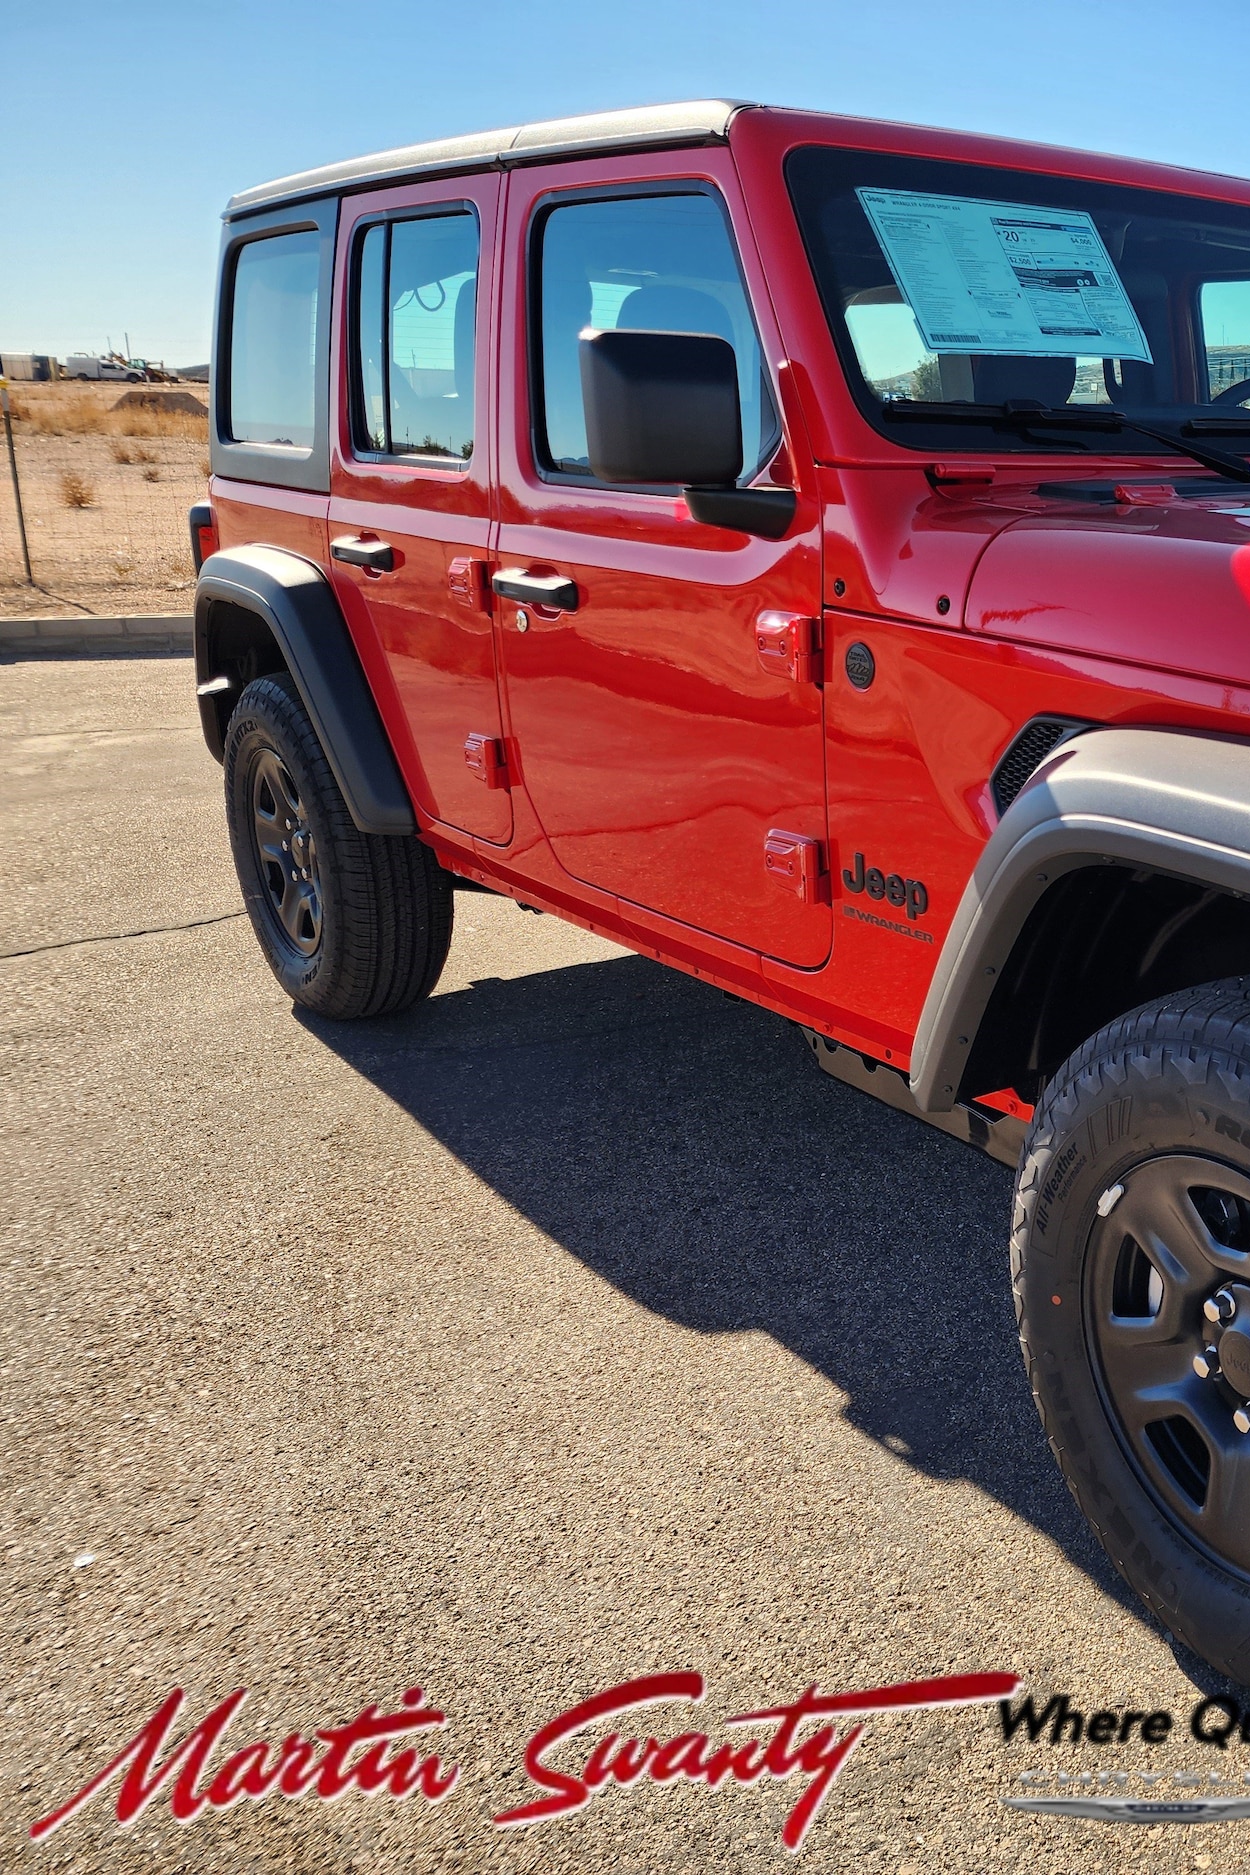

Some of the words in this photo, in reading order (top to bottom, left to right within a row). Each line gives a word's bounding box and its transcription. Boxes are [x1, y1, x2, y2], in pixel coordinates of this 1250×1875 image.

[1002, 230, 1019, 242] 20
[843, 852, 928, 920] Jeep
[855, 909, 934, 945] WRANGLER
[1035, 1142, 1079, 1236] All-Weather
[1057, 1155, 1088, 1204] Performance
